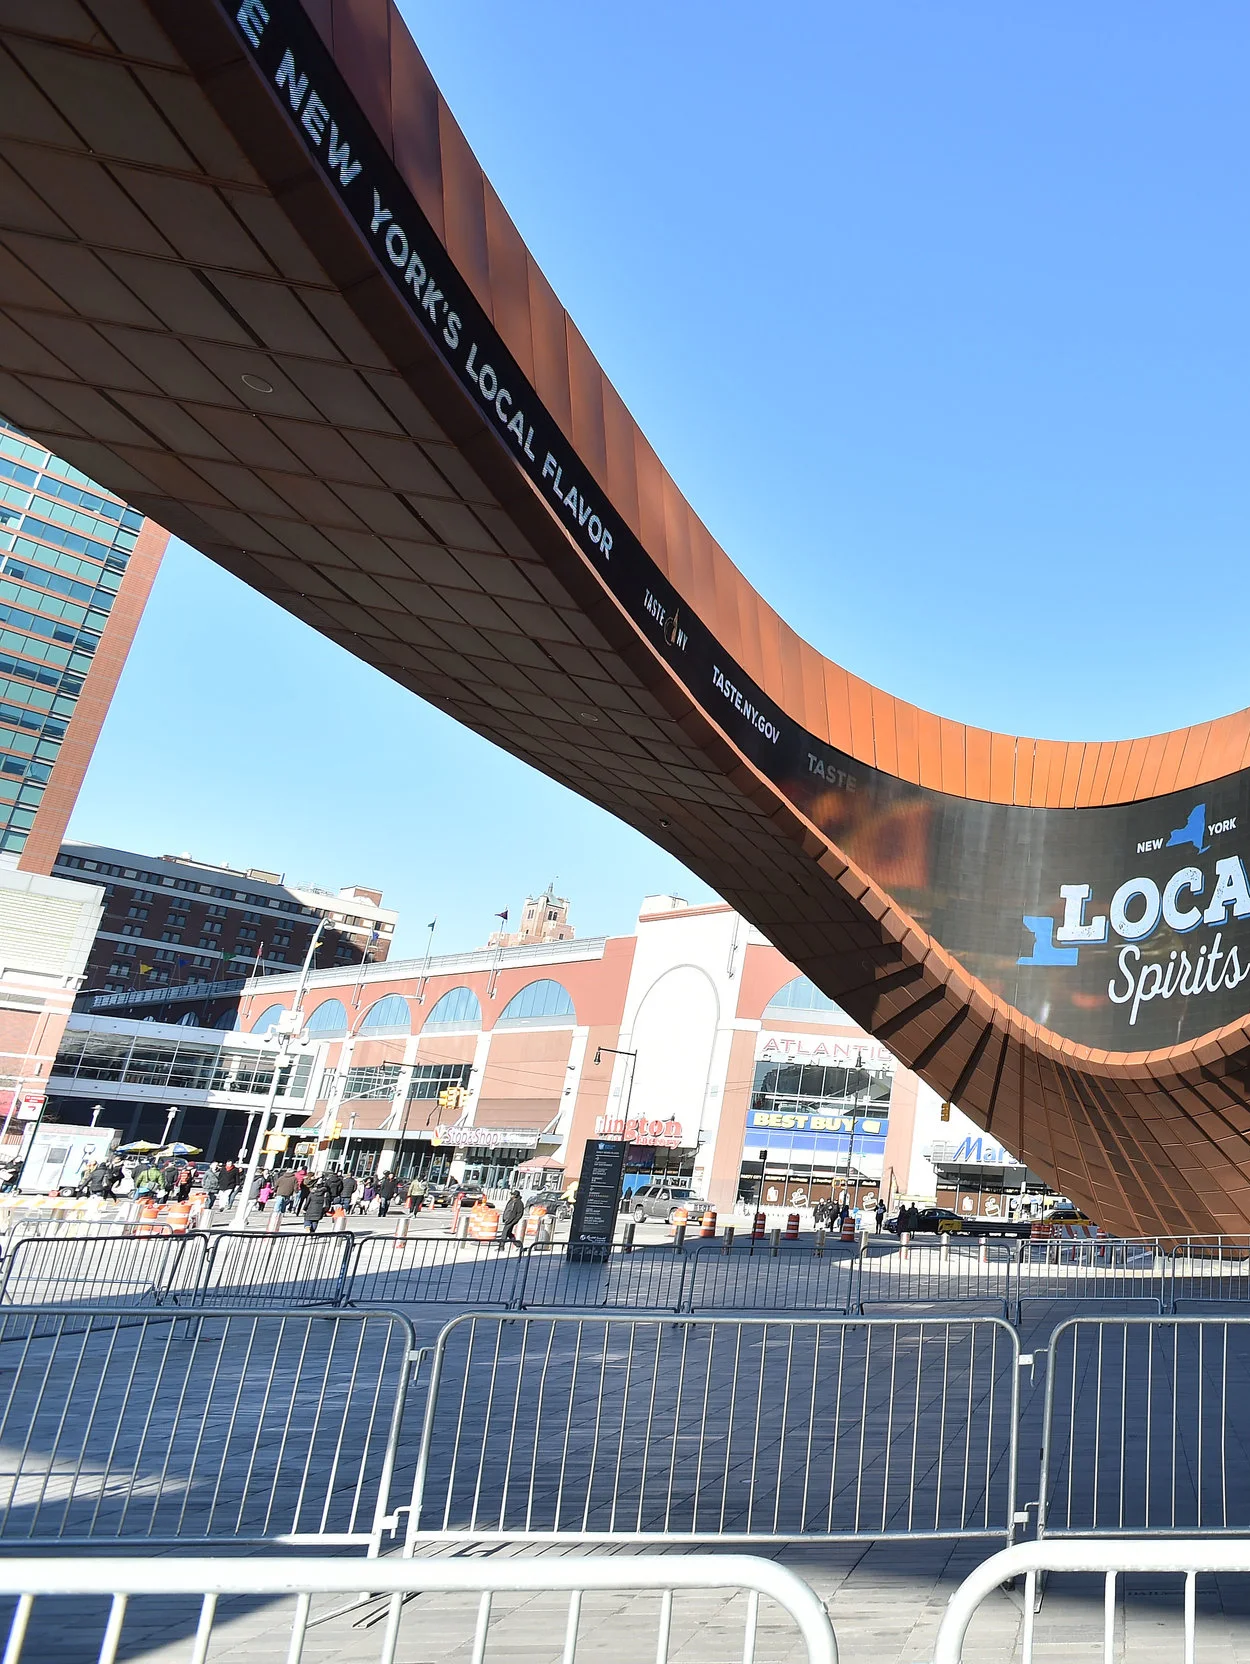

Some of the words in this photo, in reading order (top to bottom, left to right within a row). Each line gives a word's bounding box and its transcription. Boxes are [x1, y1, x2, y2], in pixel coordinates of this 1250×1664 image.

[275, 47, 363, 187] NEW
[370, 187, 463, 350] YORK'S
[466, 342, 537, 461] LOCAL
[542, 450, 614, 561] FLAVOR
[643, 588, 666, 627] TASTE
[676, 626, 689, 652] NY
[711, 665, 782, 745] TASTE.NY.GOV
[807, 752, 857, 793] TASTE
[1136, 837, 1164, 854] NEW
[1207, 816, 1238, 837] YORK
[1107, 932, 1250, 1026] Spirits
[763, 1037, 894, 1062] ATLANTIC
[753, 1112, 809, 1129] BEST
[810, 1115, 859, 1133] BUY
